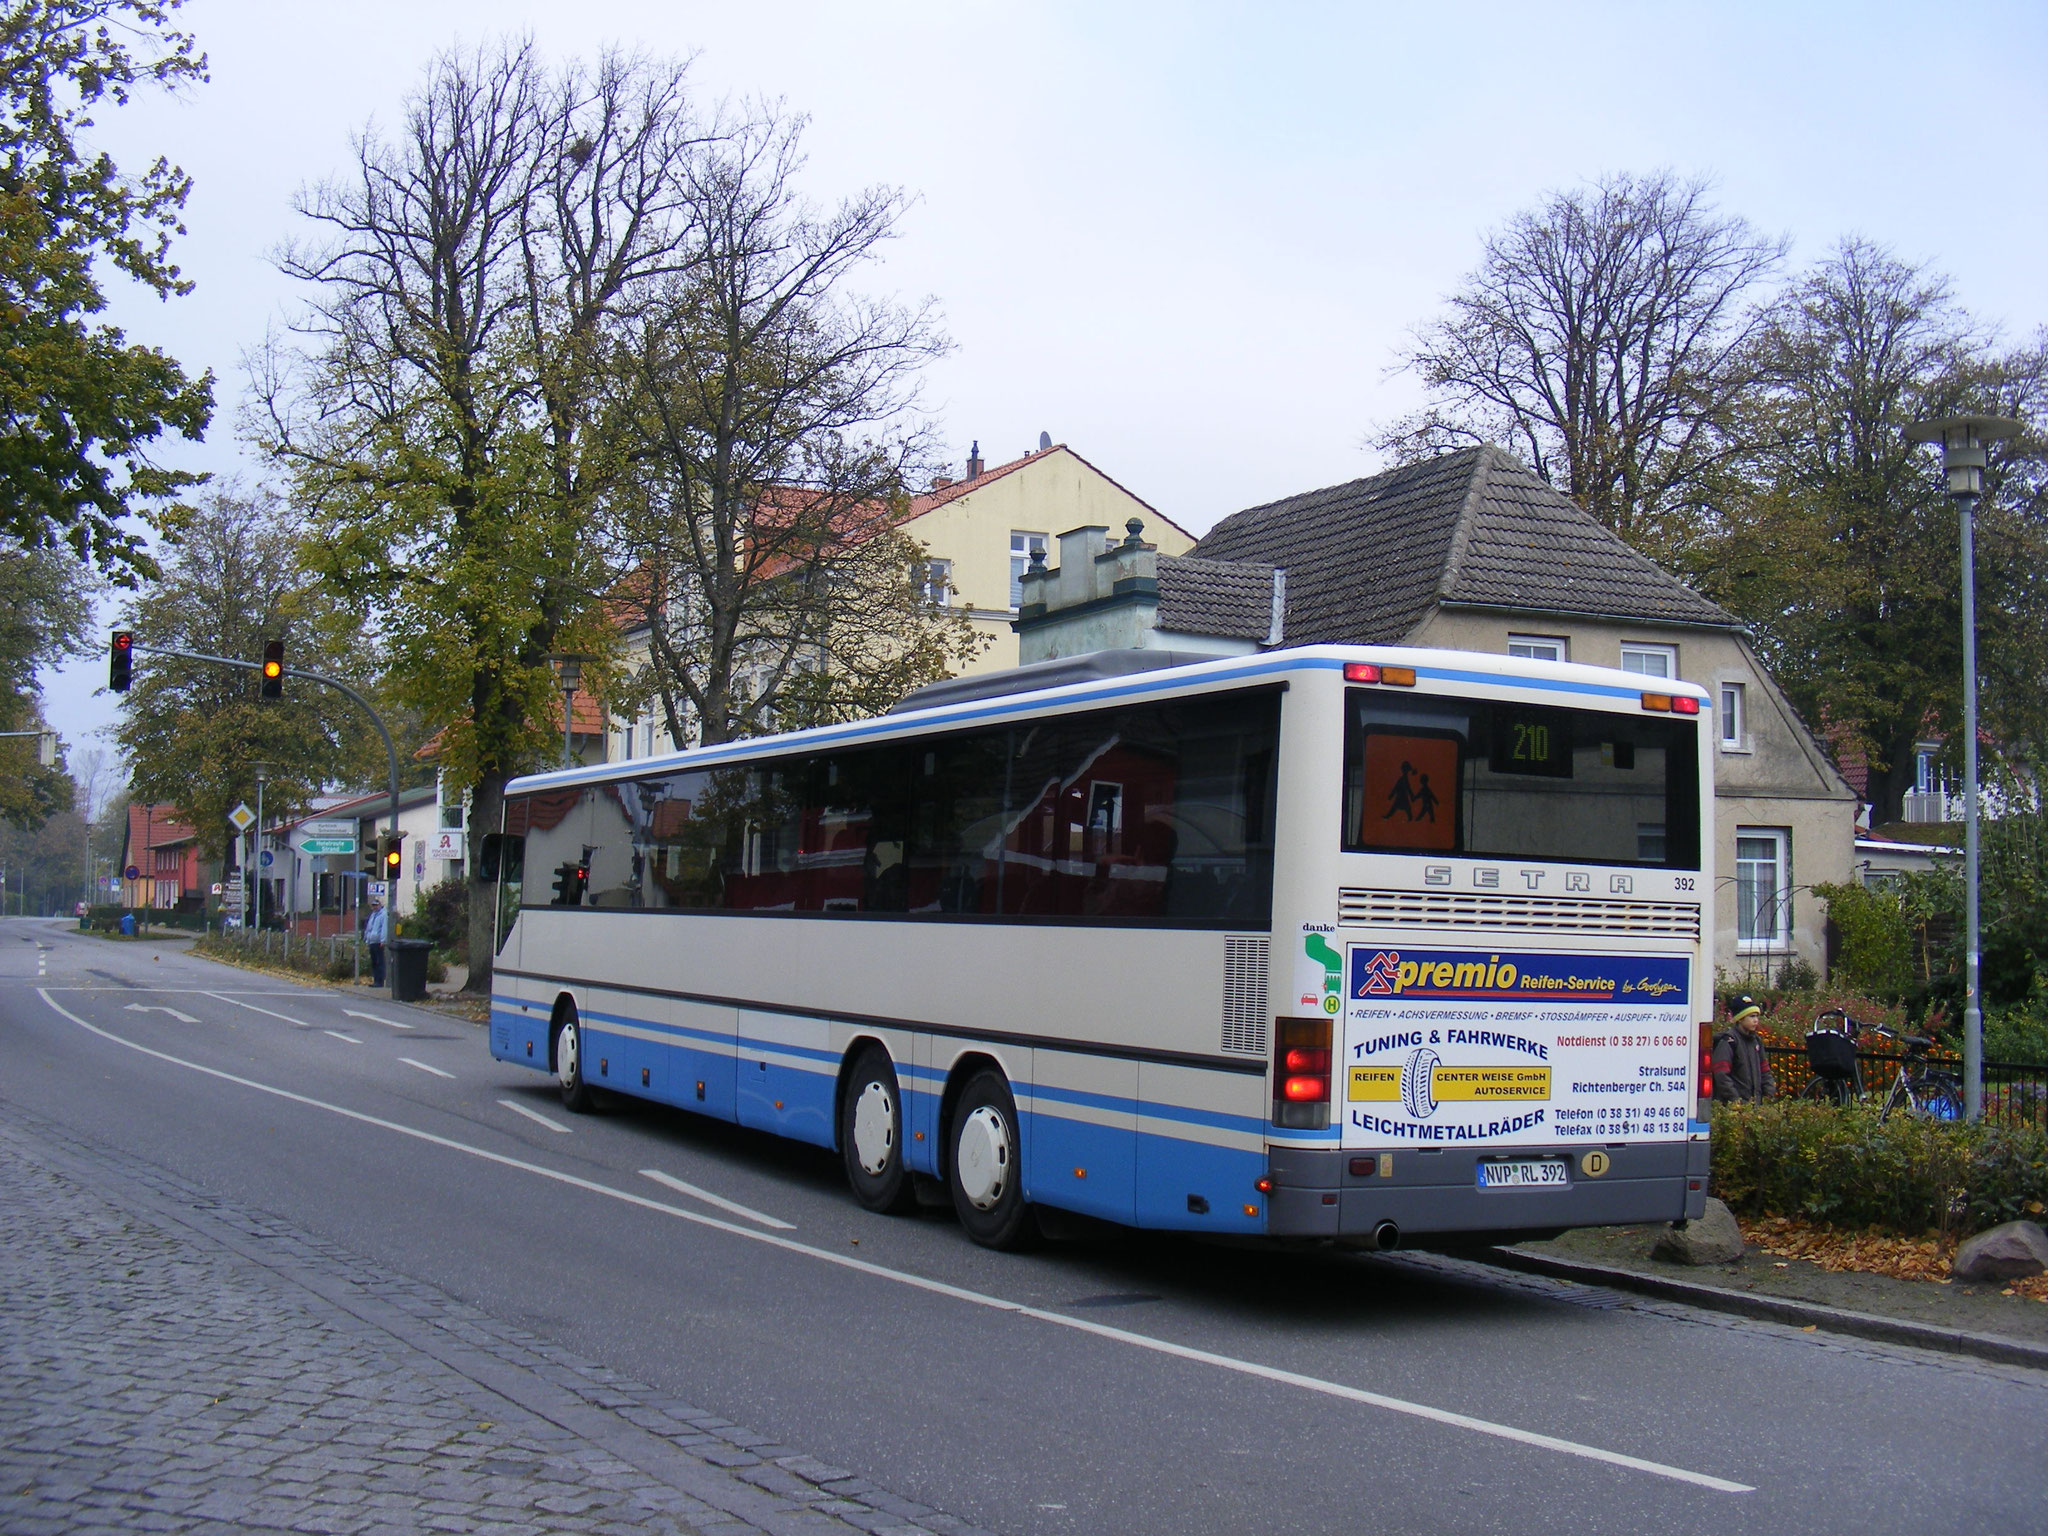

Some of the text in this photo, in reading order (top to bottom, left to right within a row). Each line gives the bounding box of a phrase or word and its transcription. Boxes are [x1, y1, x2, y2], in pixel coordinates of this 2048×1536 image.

[1513, 723, 1548, 760] 210
[1425, 866, 1633, 893] SETRA
[1674, 877, 1695, 891] 392
[1302, 923, 1336, 932] danke
[1393, 955, 1518, 993] premio
[1520, 975, 1616, 990] Reifen-Service
[1355, 1009, 1392, 1019] REIFEN
[1399, 1010, 1488, 1020] ACHSVERMESSUNG
[1614, 1013, 1653, 1022] AUSPUFF
[1354, 1029, 1549, 1061] TUNING & FAHRWERKE
[1557, 1036, 1688, 1047] Notdienst (0 38 27) 6 06 60
[1355, 1073, 1546, 1081] REIFEN CENTER WEISE GmbH
[1639, 1066, 1687, 1077] Stralsund
[1474, 1087, 1546, 1096] AUTOSERVICE
[1572, 1081, 1686, 1095] Richtenberger Ch. 54A
[1555, 1106, 1685, 1120] Telefon (0 38 31) 49 46 60
[1352, 1109, 1545, 1140] LEICHTMETALLRÄDER
[1554, 1125, 1592, 1136] Telefax
[1595, 1124, 1606, 1136] (0
[1608, 1124, 1621, 1135] 38
[1642, 1123, 1655, 1134] 48
[1658, 1123, 1670, 1133] 13
[1672, 1122, 1685, 1133] 84
[1591, 1155, 1602, 1172] D
[1485, 1164, 1566, 1184] NVP RL 392
